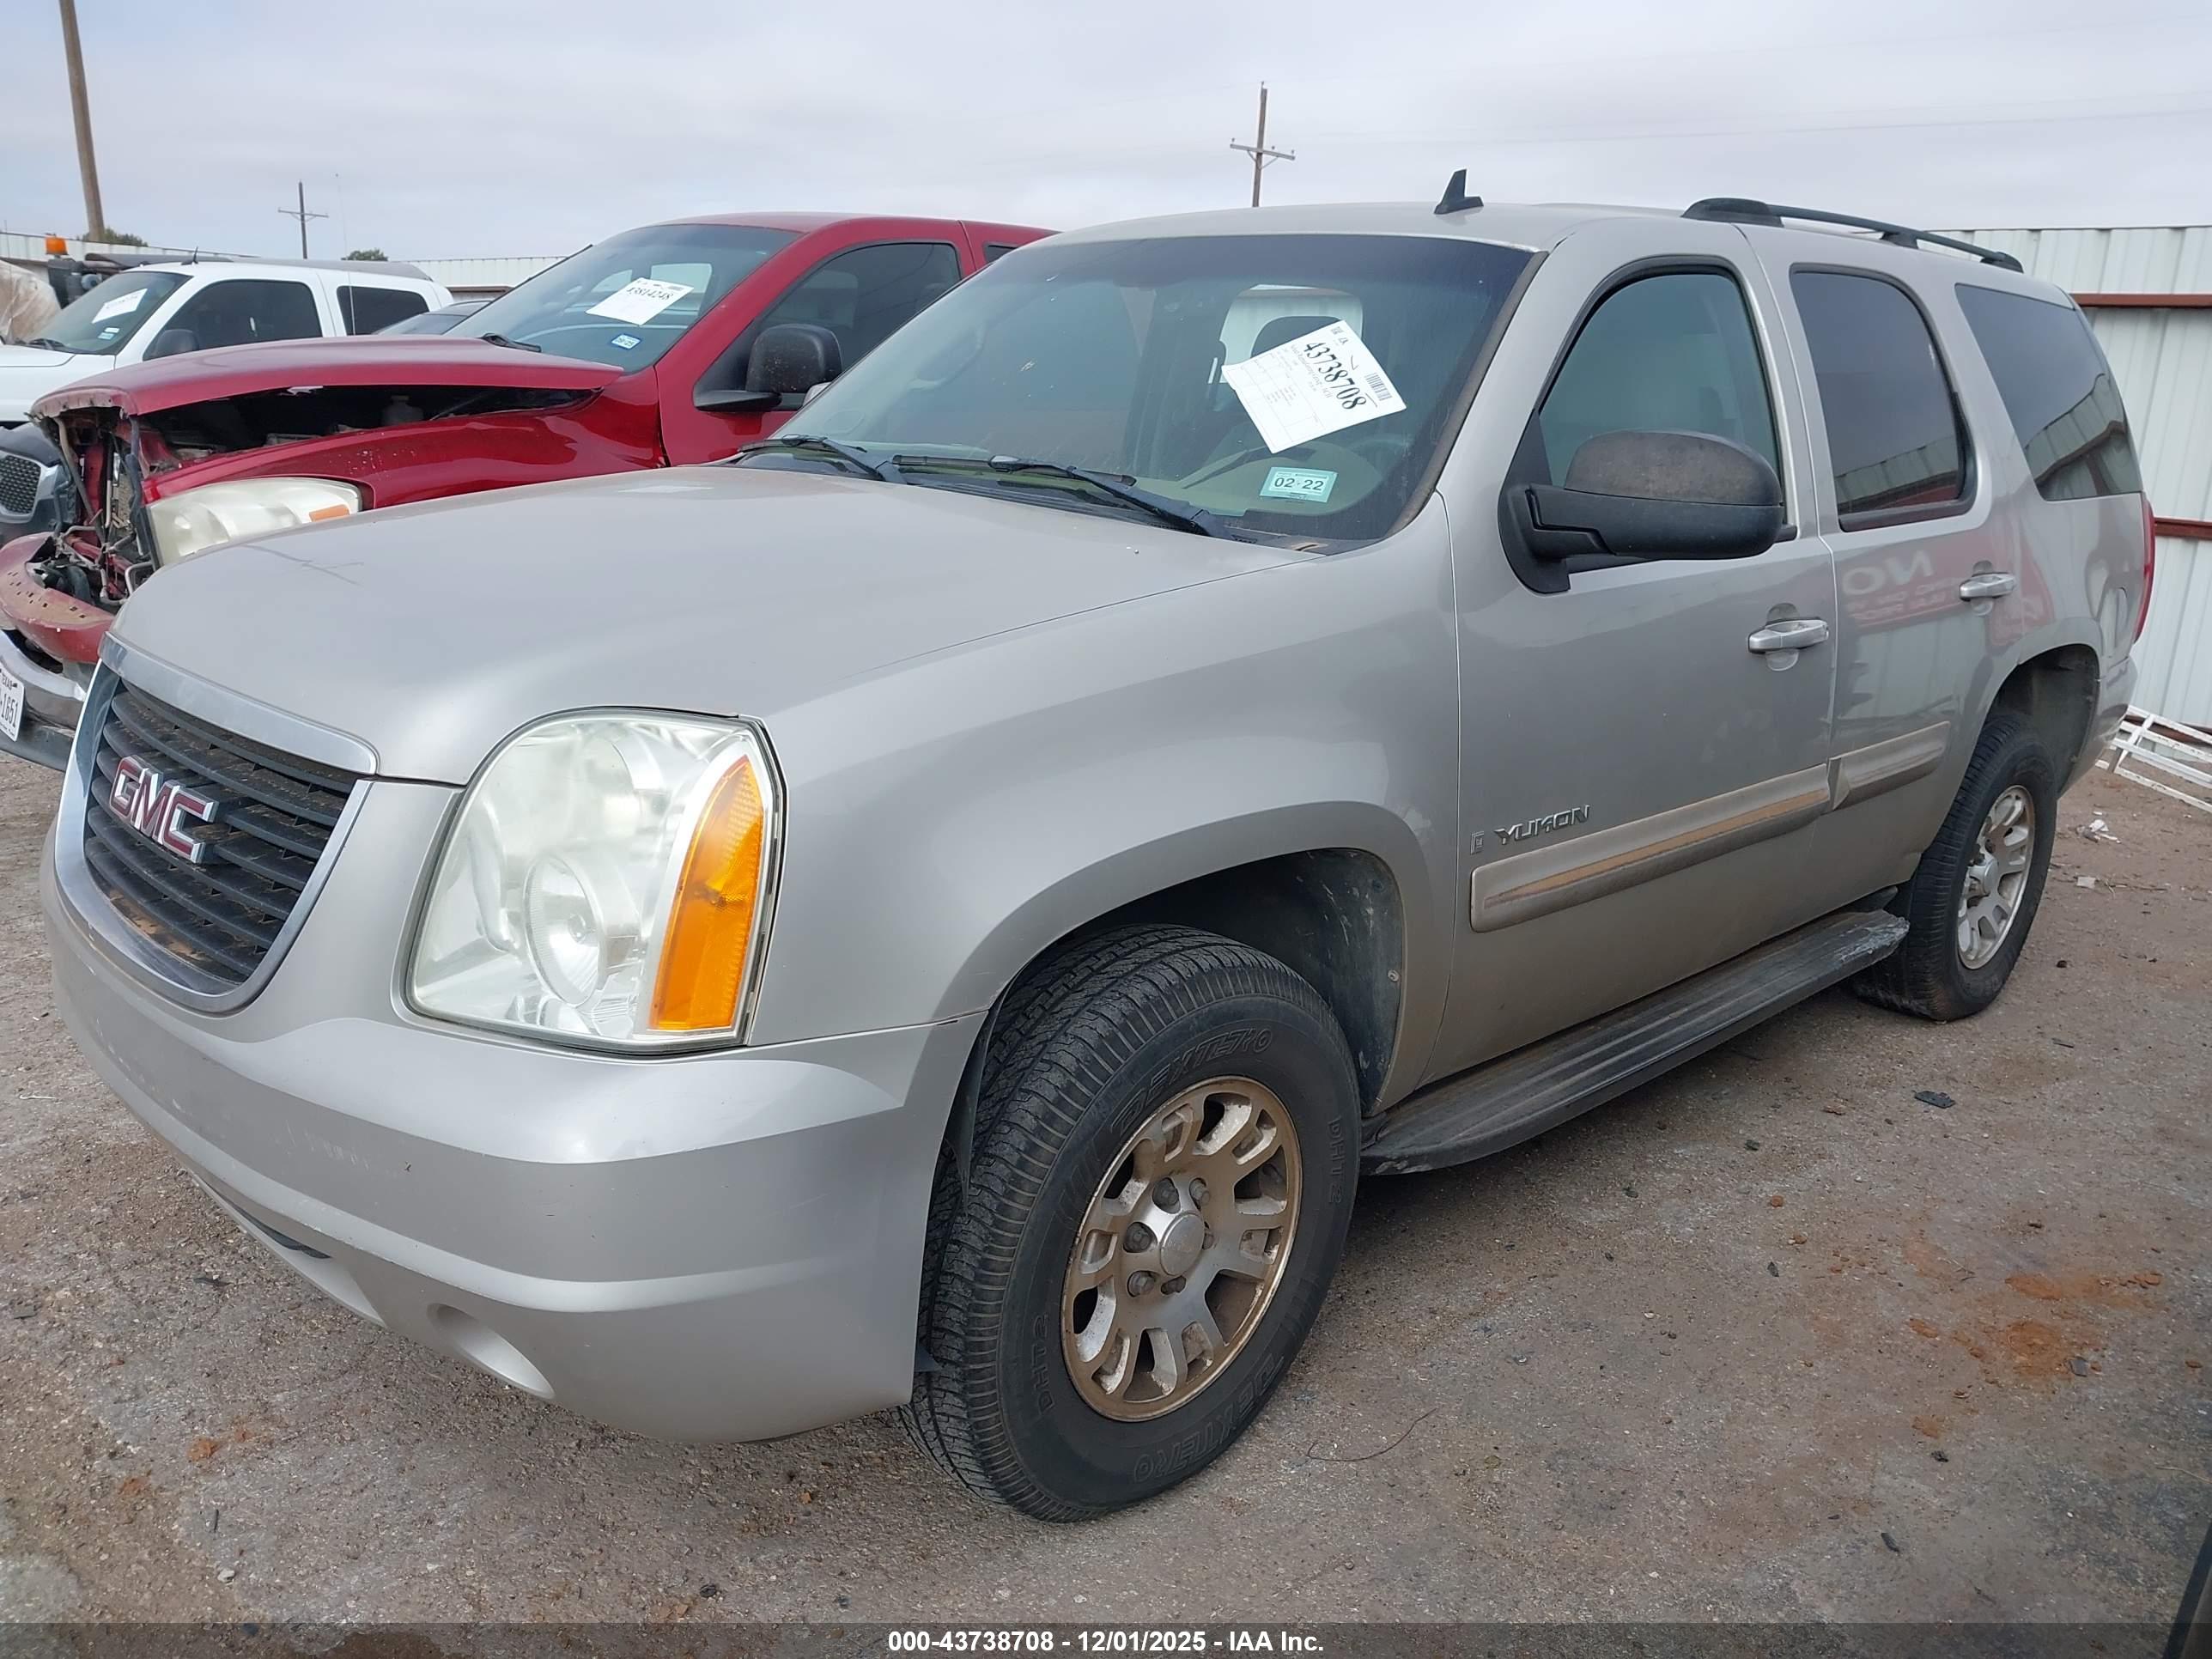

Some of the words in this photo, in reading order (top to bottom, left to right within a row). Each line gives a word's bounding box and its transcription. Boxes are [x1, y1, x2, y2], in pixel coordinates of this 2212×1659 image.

[1304, 341, 1367, 410] 43738708
[1274, 477, 1295, 488] 02
[1303, 479, 1324, 490] 22
[109, 755, 219, 864] GMC
[1493, 804, 1590, 845] YUKON
[1111, 1027, 1273, 1137] DEXTERO
